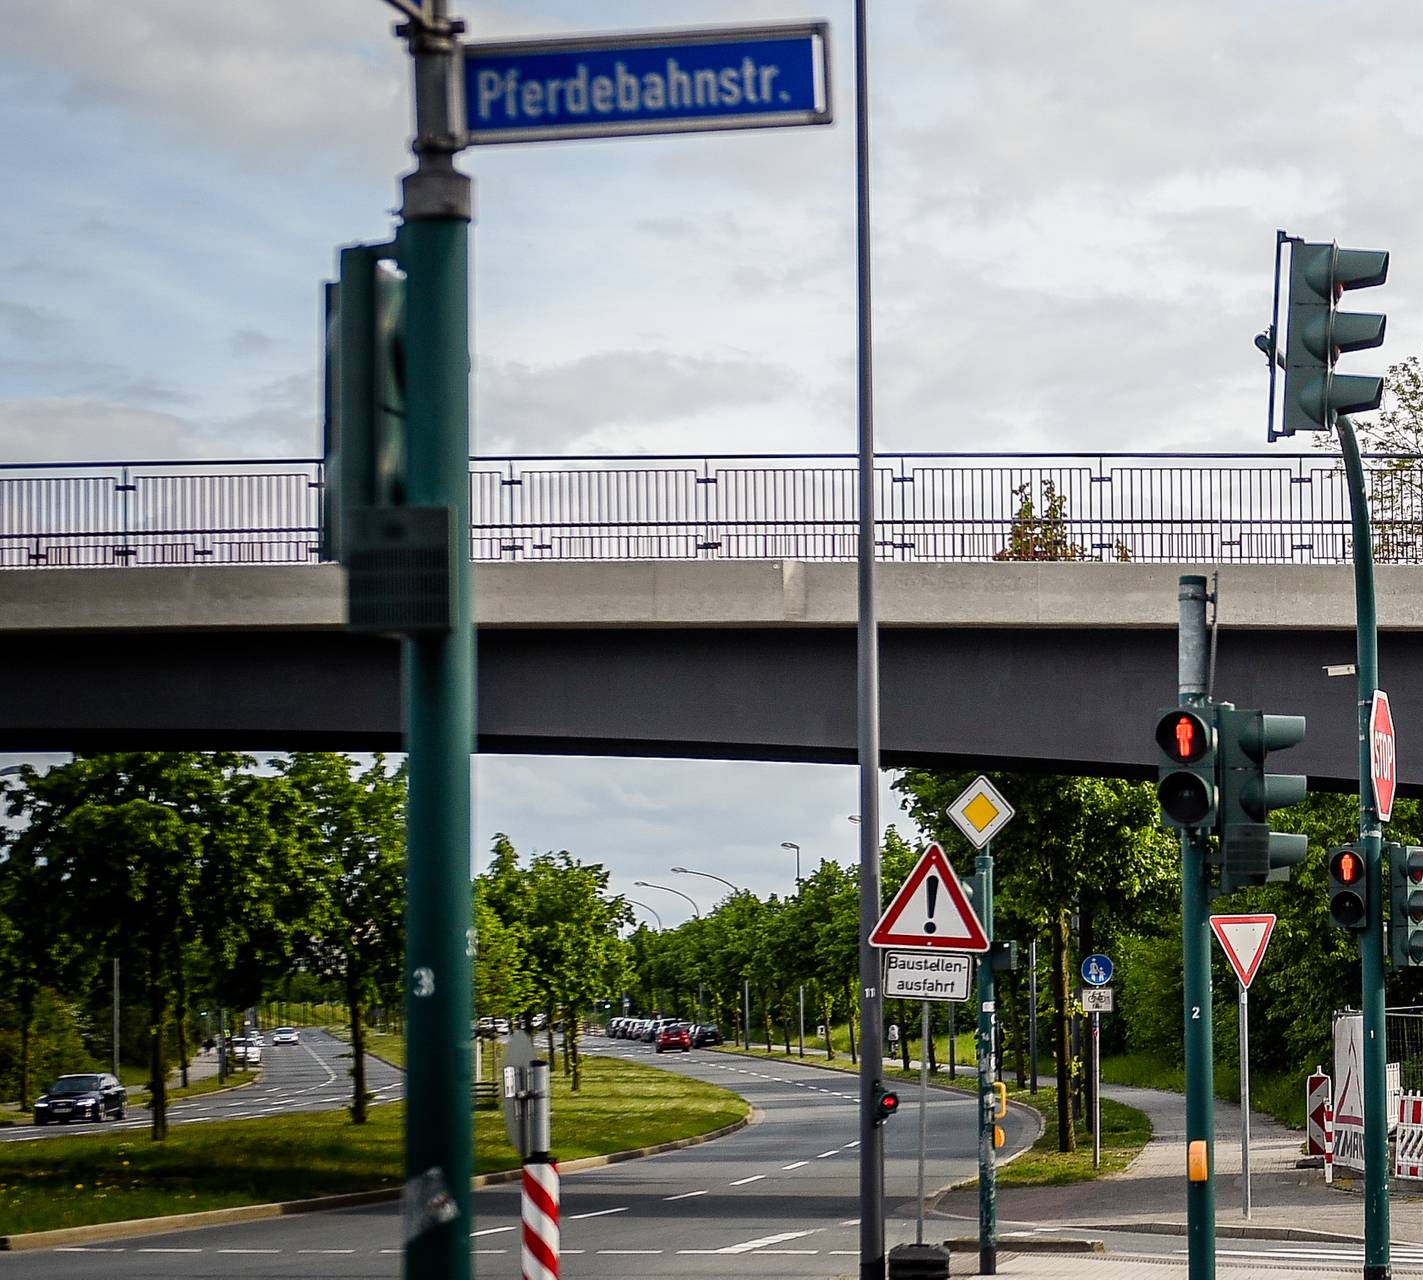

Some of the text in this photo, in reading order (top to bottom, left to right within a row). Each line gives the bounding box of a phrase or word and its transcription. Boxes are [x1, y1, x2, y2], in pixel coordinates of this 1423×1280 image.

[477, 57, 791, 120] Pferdebahnstr.
[1374, 730, 1393, 781] STOP
[888, 956, 967, 973] Baustellen-
[413, 967, 435, 997] 3
[896, 979, 955, 993] ausfahrt
[864, 987, 876, 999] 11
[1191, 1006, 1200, 1019] 2
